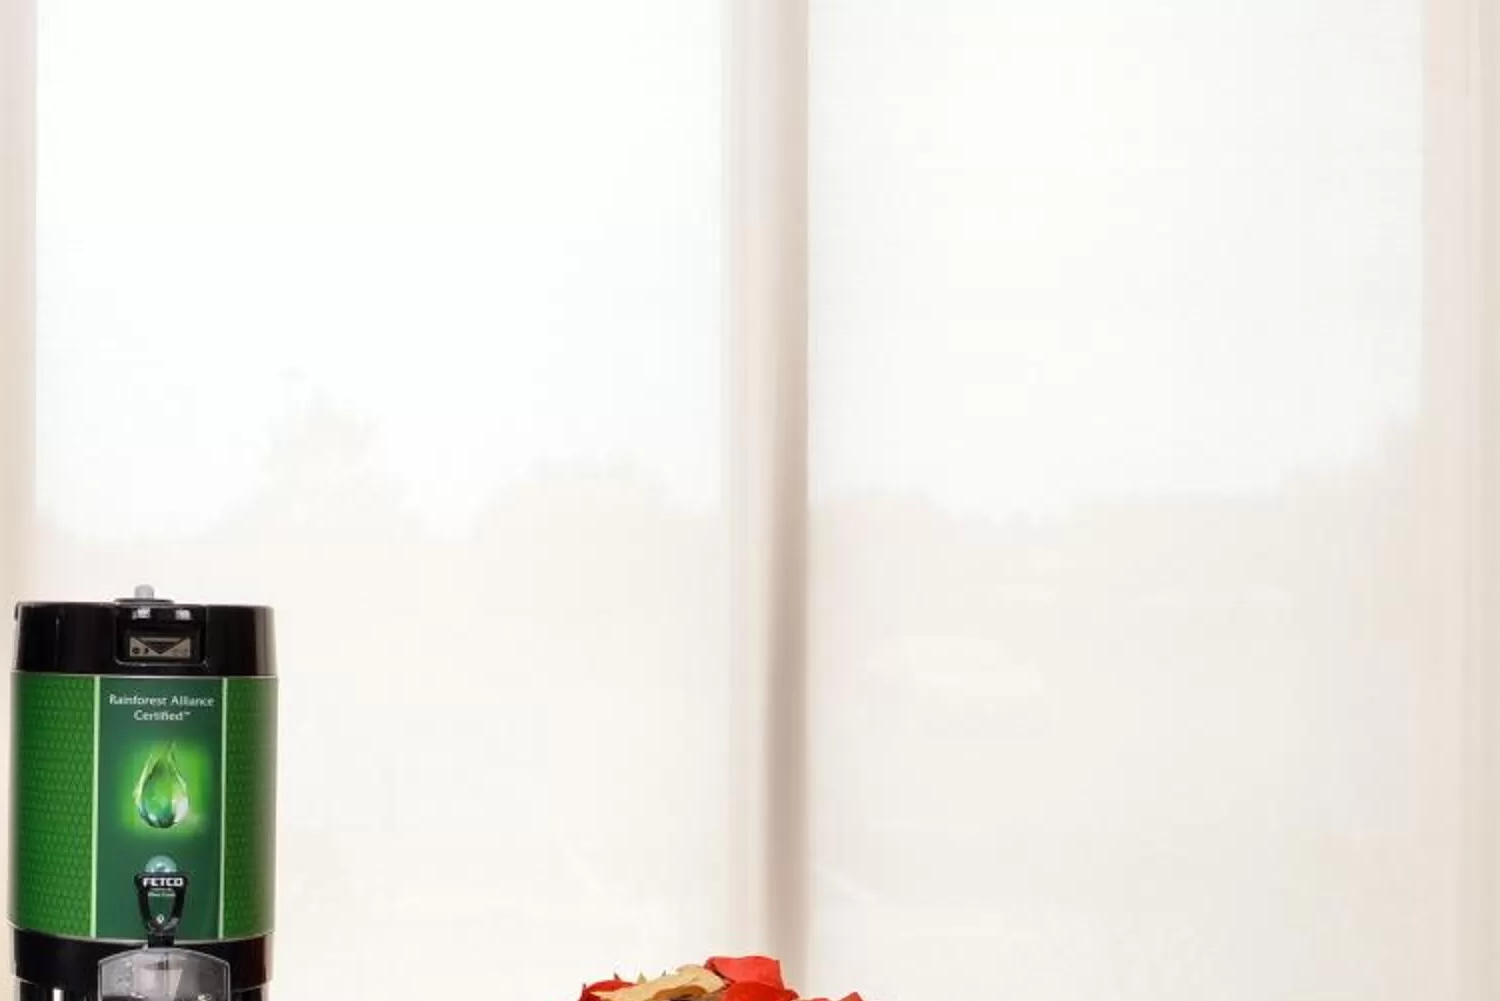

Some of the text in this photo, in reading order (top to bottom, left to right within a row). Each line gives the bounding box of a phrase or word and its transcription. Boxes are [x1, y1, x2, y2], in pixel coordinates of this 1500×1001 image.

[109, 694, 214, 707] Rainforest Alliance
[142, 877, 183, 887] FETCO
